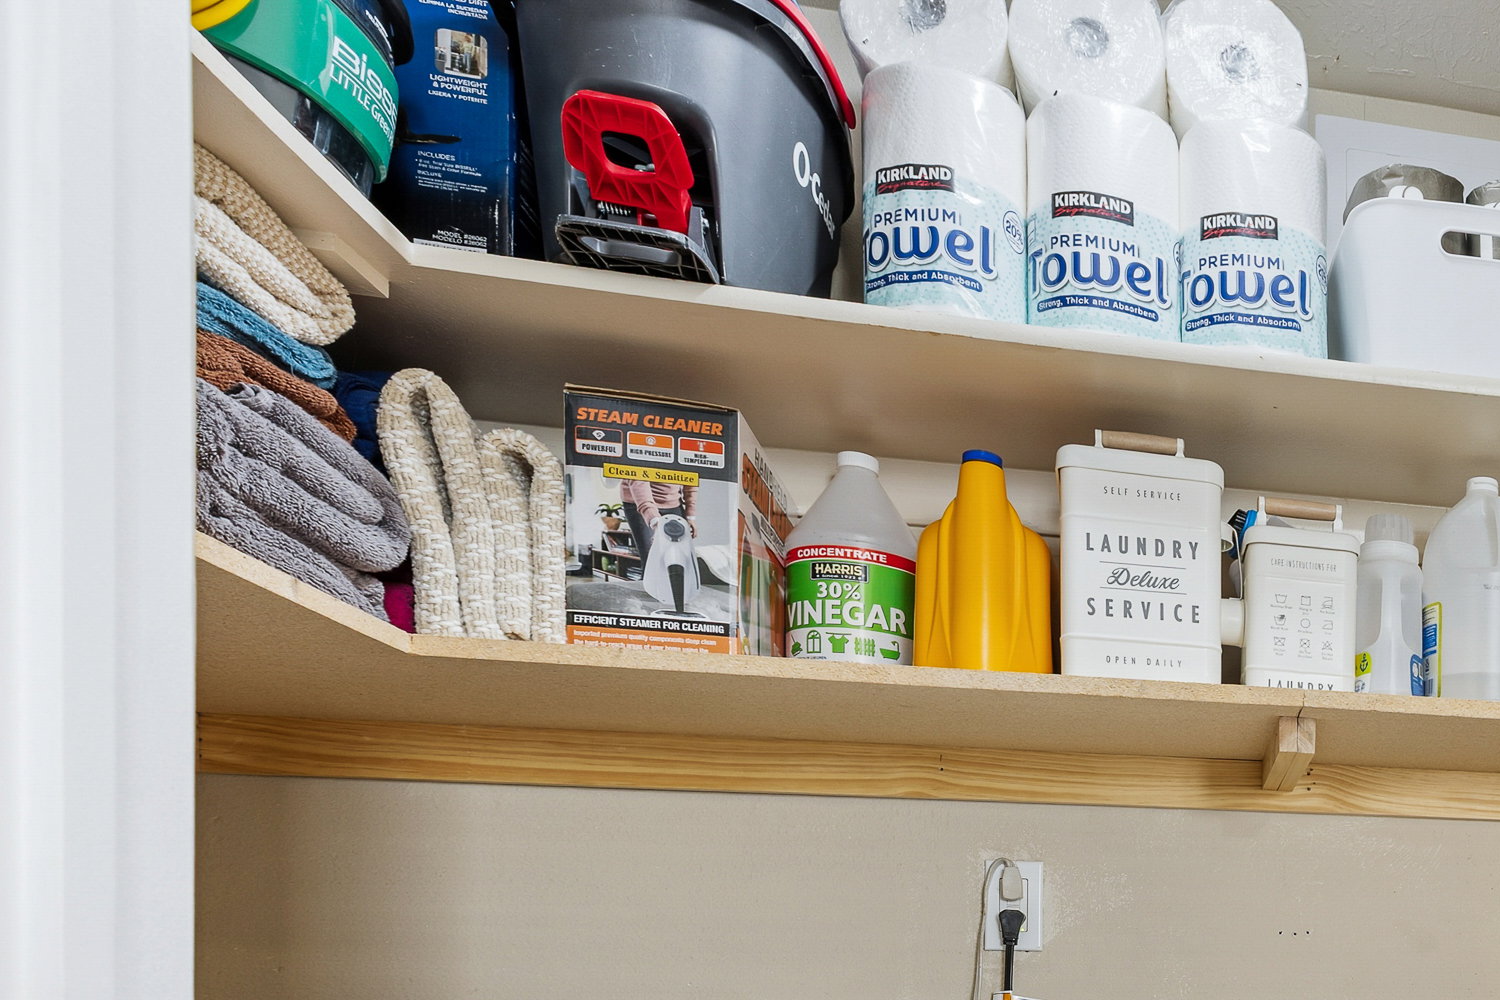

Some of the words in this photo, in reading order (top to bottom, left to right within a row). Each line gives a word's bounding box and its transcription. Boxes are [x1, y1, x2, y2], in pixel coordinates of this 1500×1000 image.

[329, 63, 370, 112] LITTLE
[429, 73, 488, 89] LIGHTWEIGHT
[440, 82, 488, 96] POWERFUL
[417, 150, 456, 161] INCLUDES
[877, 165, 952, 184] KIRKLAND
[1055, 192, 1132, 215] KIRKLAND
[874, 207, 957, 228] PREMIUM
[1203, 213, 1277, 231] KIRKLAND
[432, 234, 463, 244] MODELO
[437, 229, 462, 239] MODEL
[1050, 233, 1136, 258] PREMIUM
[1199, 253, 1281, 271] PREMIUM
[888, 273, 910, 283] Thick
[911, 272, 928, 281] and
[930, 271, 981, 292] Absorbent
[1029, 248, 1168, 305] Towel
[1065, 296, 1090, 306] Thick
[1091, 298, 1110, 308] and
[1112, 301, 1157, 320] Absorbent
[1212, 314, 1236, 323] Thick
[1237, 316, 1254, 324] and
[576, 407, 639, 426] STEAM
[642, 414, 724, 436] CLEANER
[581, 443, 617, 454] POWERFUL
[644, 449, 672, 459] PRESSURE
[683, 457, 719, 467] TEMPERATURE
[608, 466, 637, 477] Clean
[641, 470, 650, 479] &
[654, 474, 695, 484] Sanitize
[1103, 485, 1129, 496] SELF
[1137, 489, 1182, 501] SERVICE
[797, 547, 888, 563] CONCENTRATE
[1086, 532, 1199, 560] LAUNDRY
[815, 563, 862, 576] HARRIS
[1270, 557, 1284, 567] CARE
[1285, 559, 1325, 571] INSTRUCTIONS
[1326, 563, 1337, 573] FOR
[1106, 567, 1180, 591] Deluxe
[816, 581, 862, 600] 30%
[787, 599, 907, 635] VINEGAR
[1087, 597, 1201, 624] SERVICE
[573, 614, 617, 626] EFFICIENT
[619, 617, 661, 629] STEAMER
[662, 621, 680, 631] FOR
[681, 624, 725, 634] CLEANING
[1105, 655, 1137, 665] OPEN
[1146, 658, 1183, 668] DAILY
